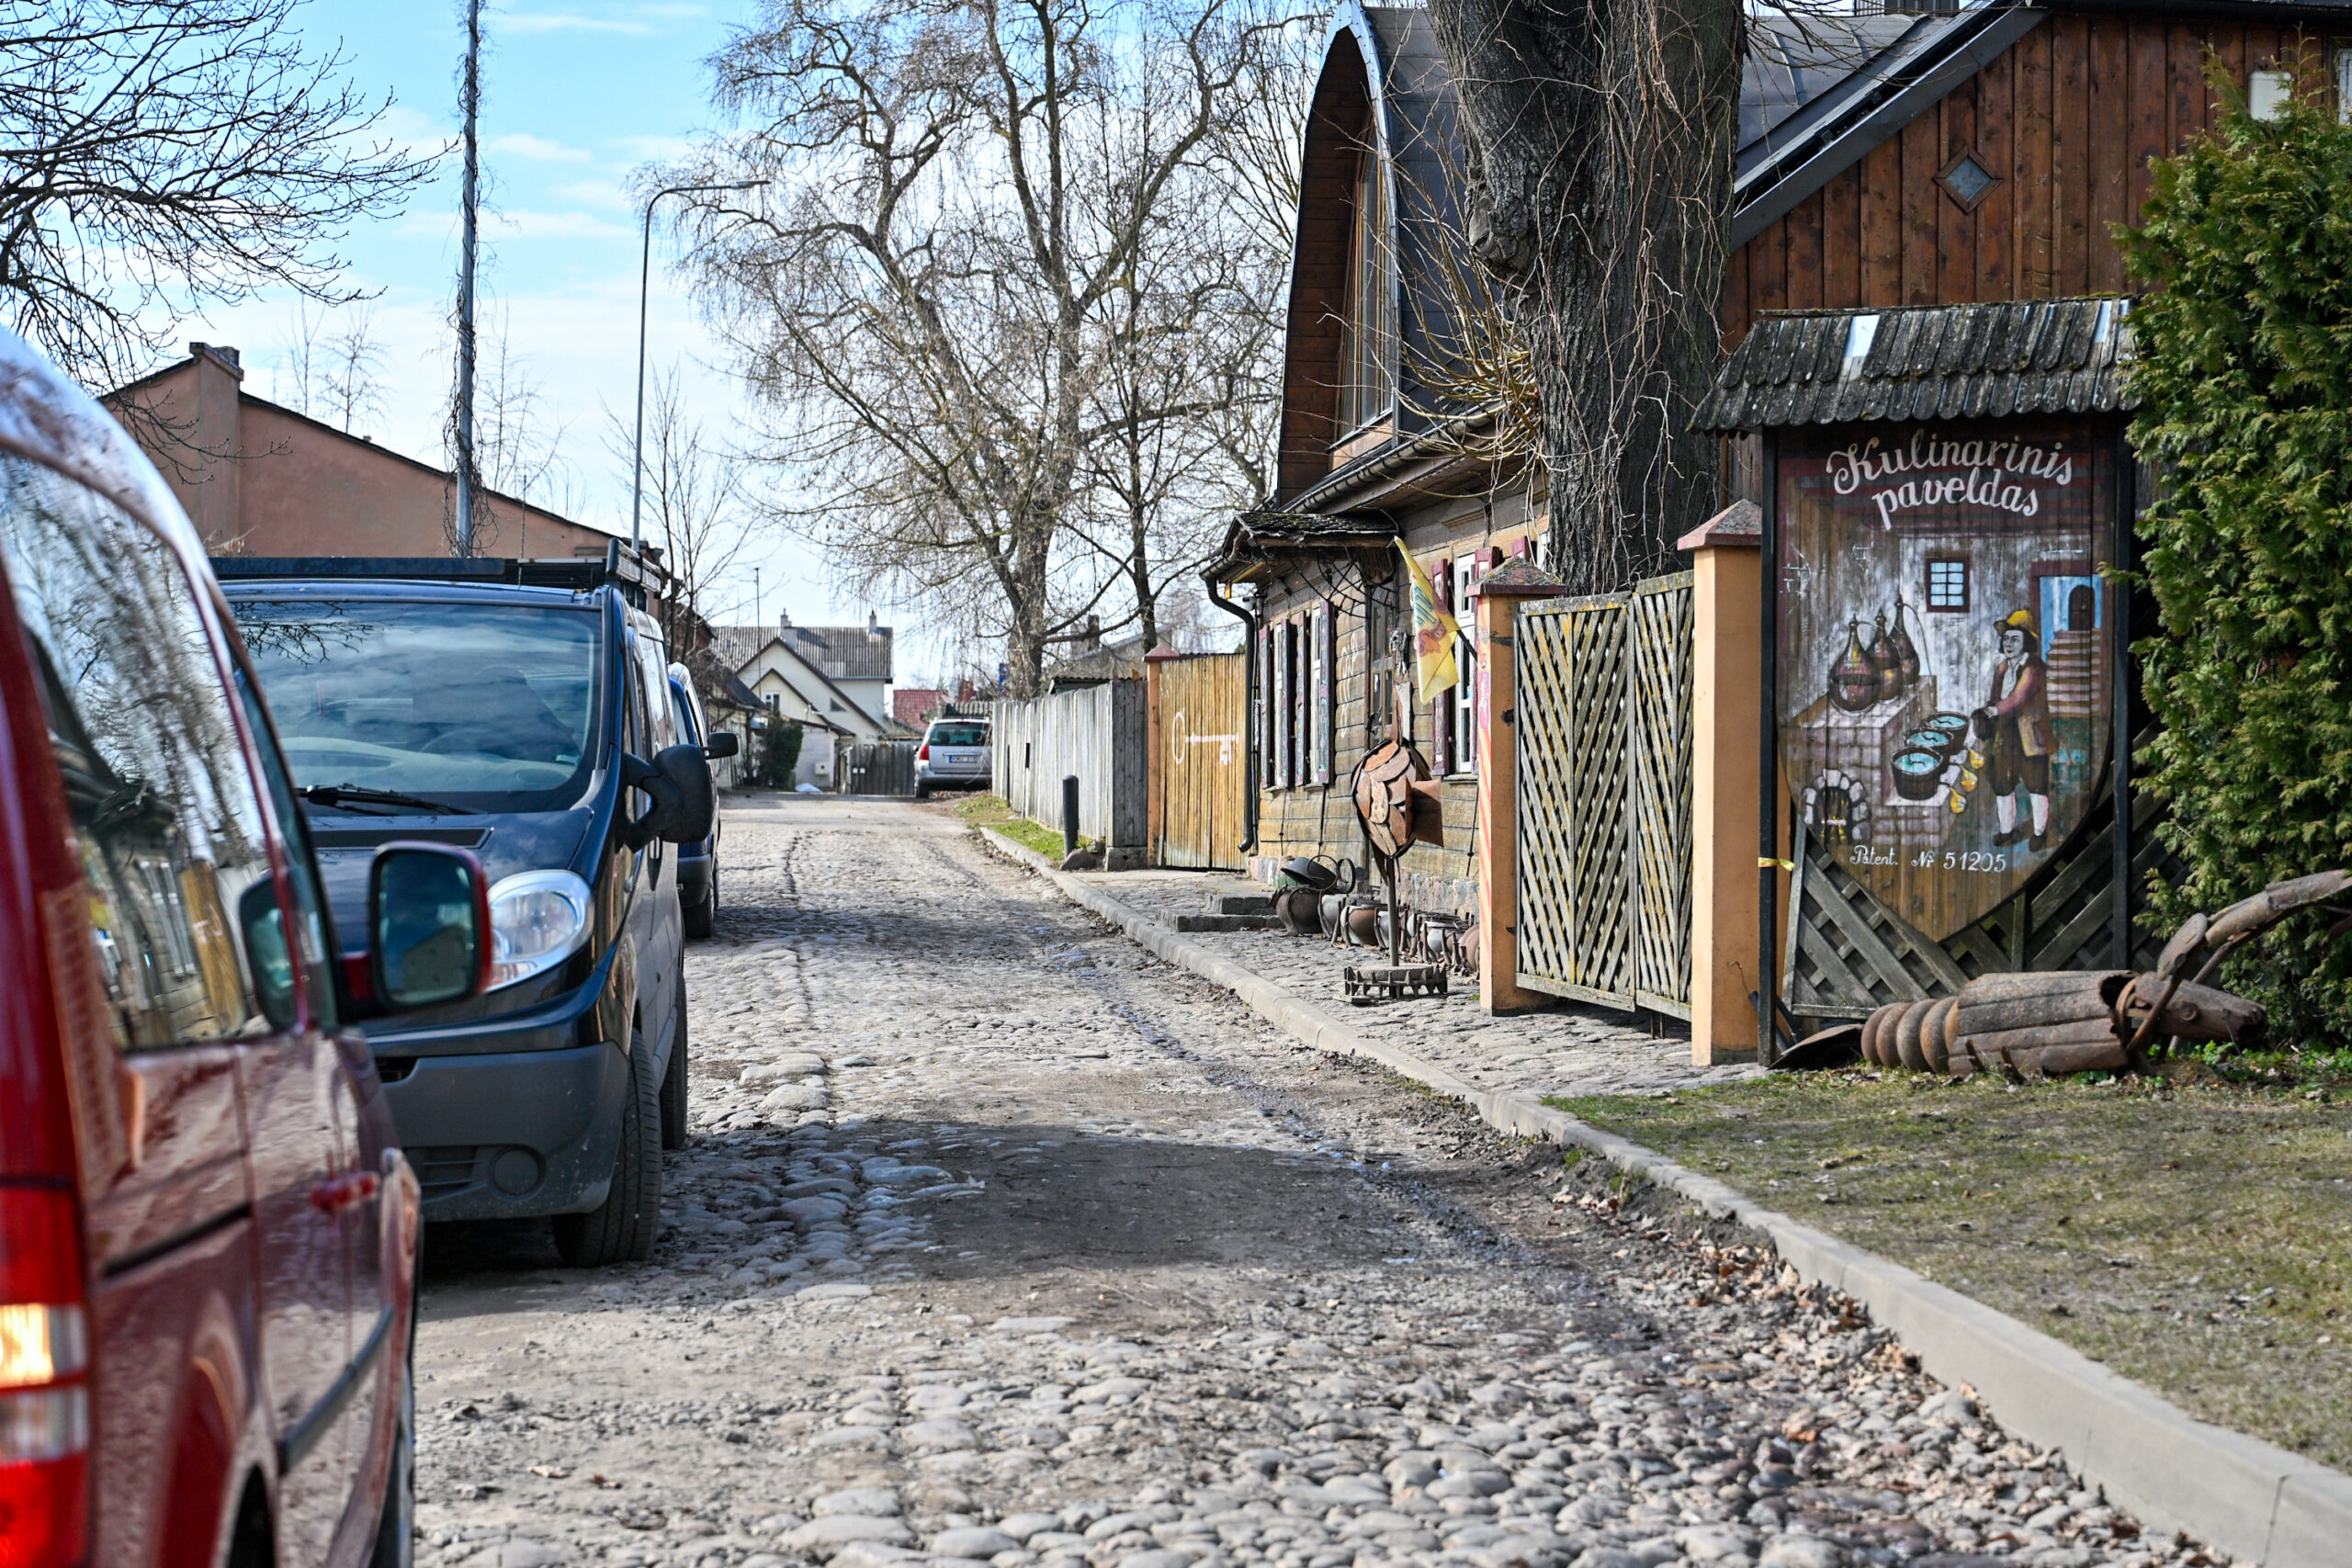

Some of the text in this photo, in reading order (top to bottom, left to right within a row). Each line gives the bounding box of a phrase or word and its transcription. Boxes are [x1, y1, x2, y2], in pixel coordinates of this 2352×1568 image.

[1826, 428, 2073, 495] Kulinarinis
[1871, 467, 2039, 531] paveldas
[1943, 851, 2007, 873] 51205
